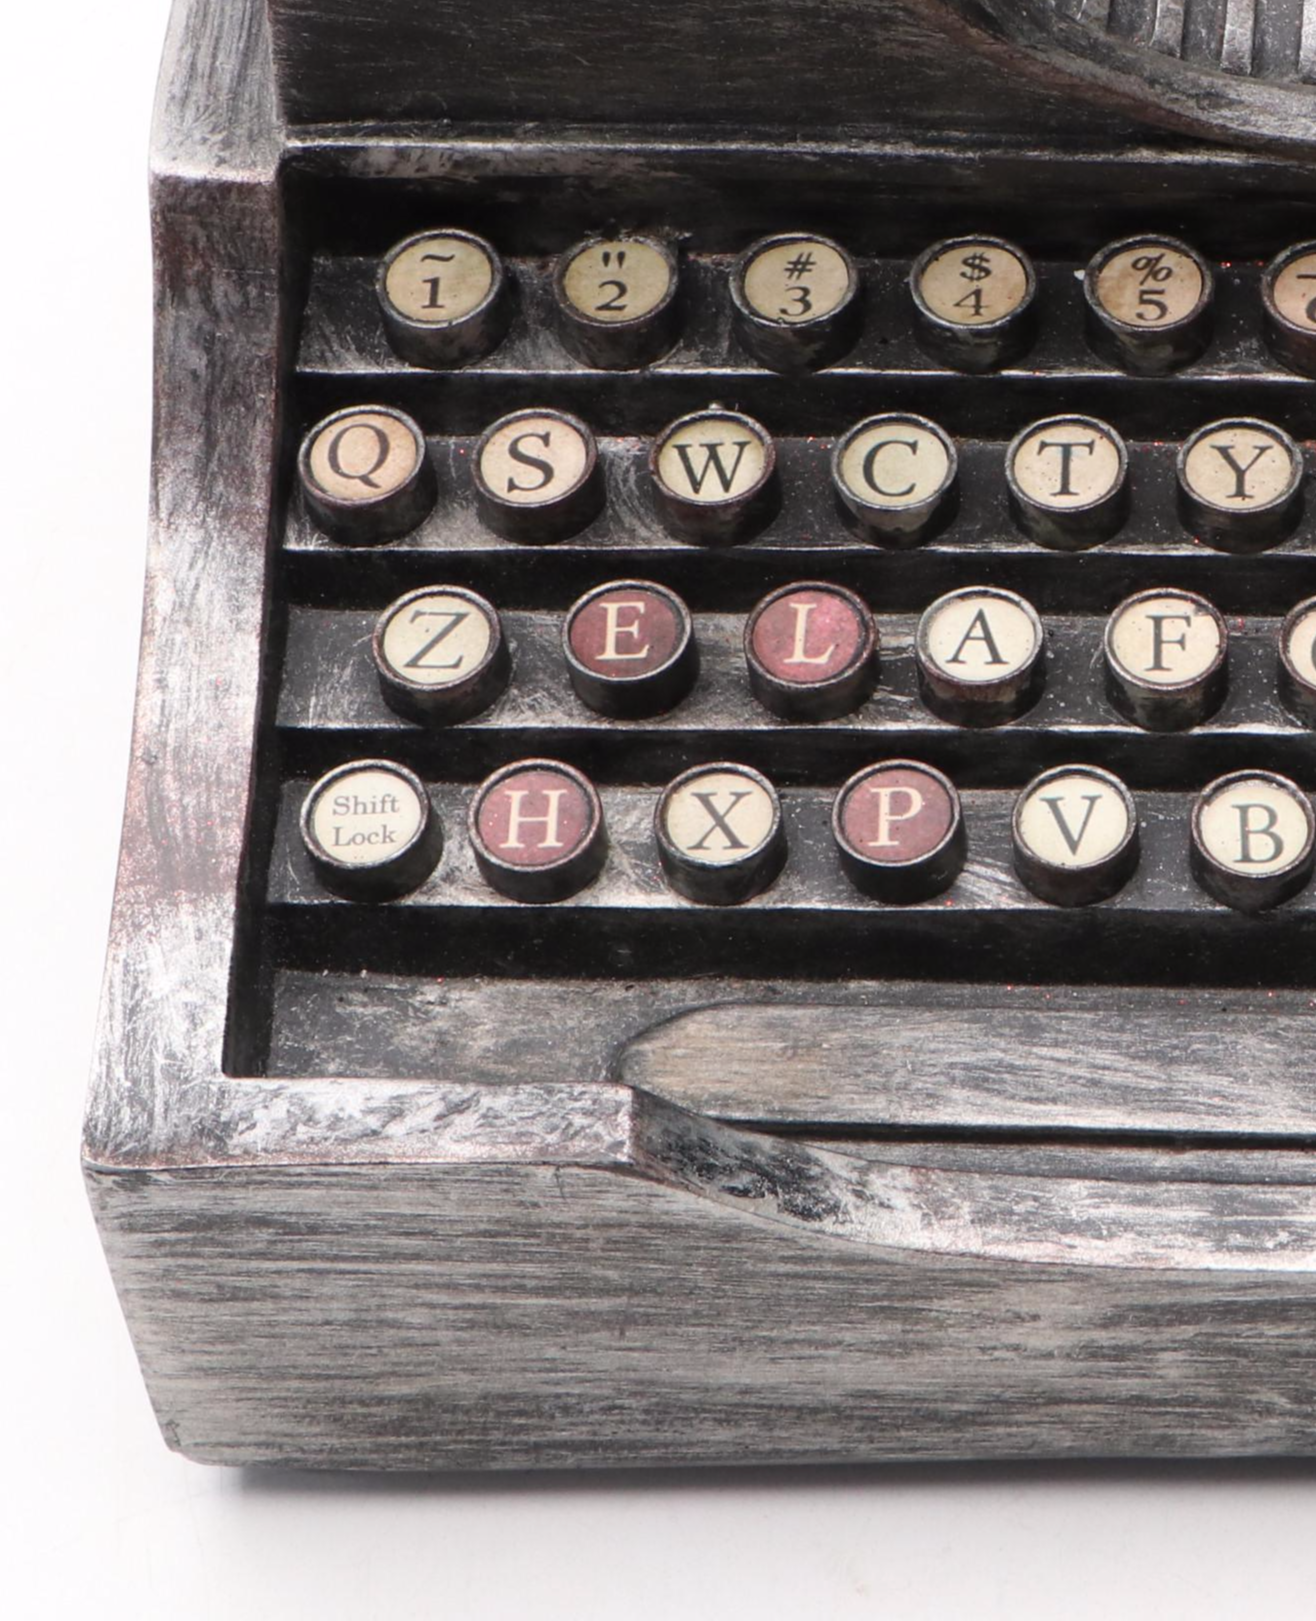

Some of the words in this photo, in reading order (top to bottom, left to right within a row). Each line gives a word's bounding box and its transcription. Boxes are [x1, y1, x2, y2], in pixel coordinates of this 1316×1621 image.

[422, 277, 444, 308] 1
[784, 253, 816, 279] #
[960, 253, 991, 282] $
[1131, 253, 1173, 285] %
[595, 280, 627, 311] 2
[780, 286, 812, 316] 3
[954, 288, 989, 317] 4
[1136, 289, 1167, 320] 5
[327, 423, 390, 489] Q
[507, 432, 554, 493] S
[673, 441, 752, 493] W
[863, 440, 918, 497] C
[1037, 439, 1095, 496] T
[1210, 445, 1273, 500] Y
[404, 610, 470, 669] Z
[596, 602, 649, 659] E
[783, 603, 839, 664] L
[946, 609, 1008, 664] A
[1146, 615, 1191, 671] F
[333, 794, 399, 815] Shift
[500, 790, 567, 848] H
[687, 792, 752, 850] X
[868, 787, 922, 846] P
[1040, 795, 1101, 855] V
[332, 824, 396, 846] Lock
[1232, 804, 1284, 863] B
